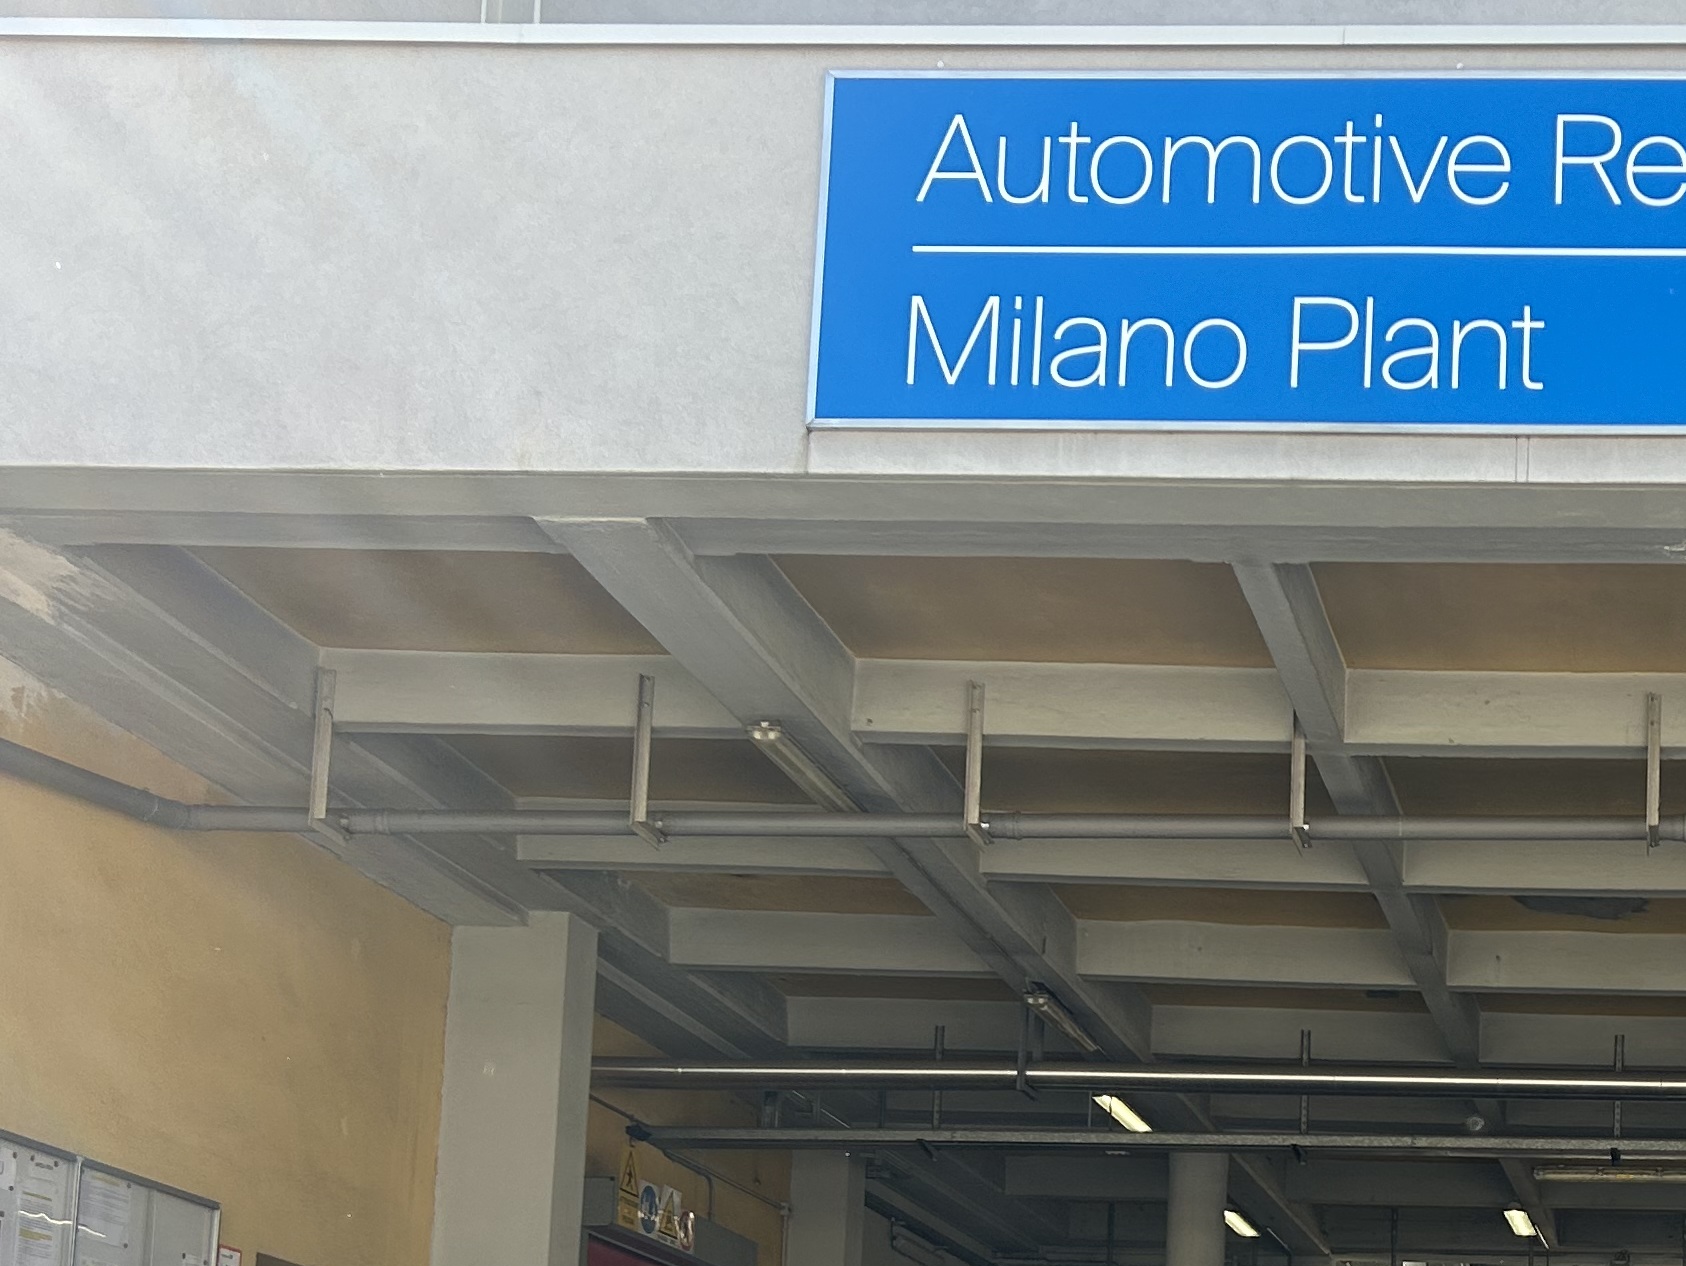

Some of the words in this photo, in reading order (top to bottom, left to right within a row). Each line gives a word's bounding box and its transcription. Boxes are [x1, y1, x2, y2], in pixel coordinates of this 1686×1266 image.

[916, 113, 1511, 209] Automotive
[906, 294, 1247, 390] Milano
[1290, 296, 1546, 393] Plant
